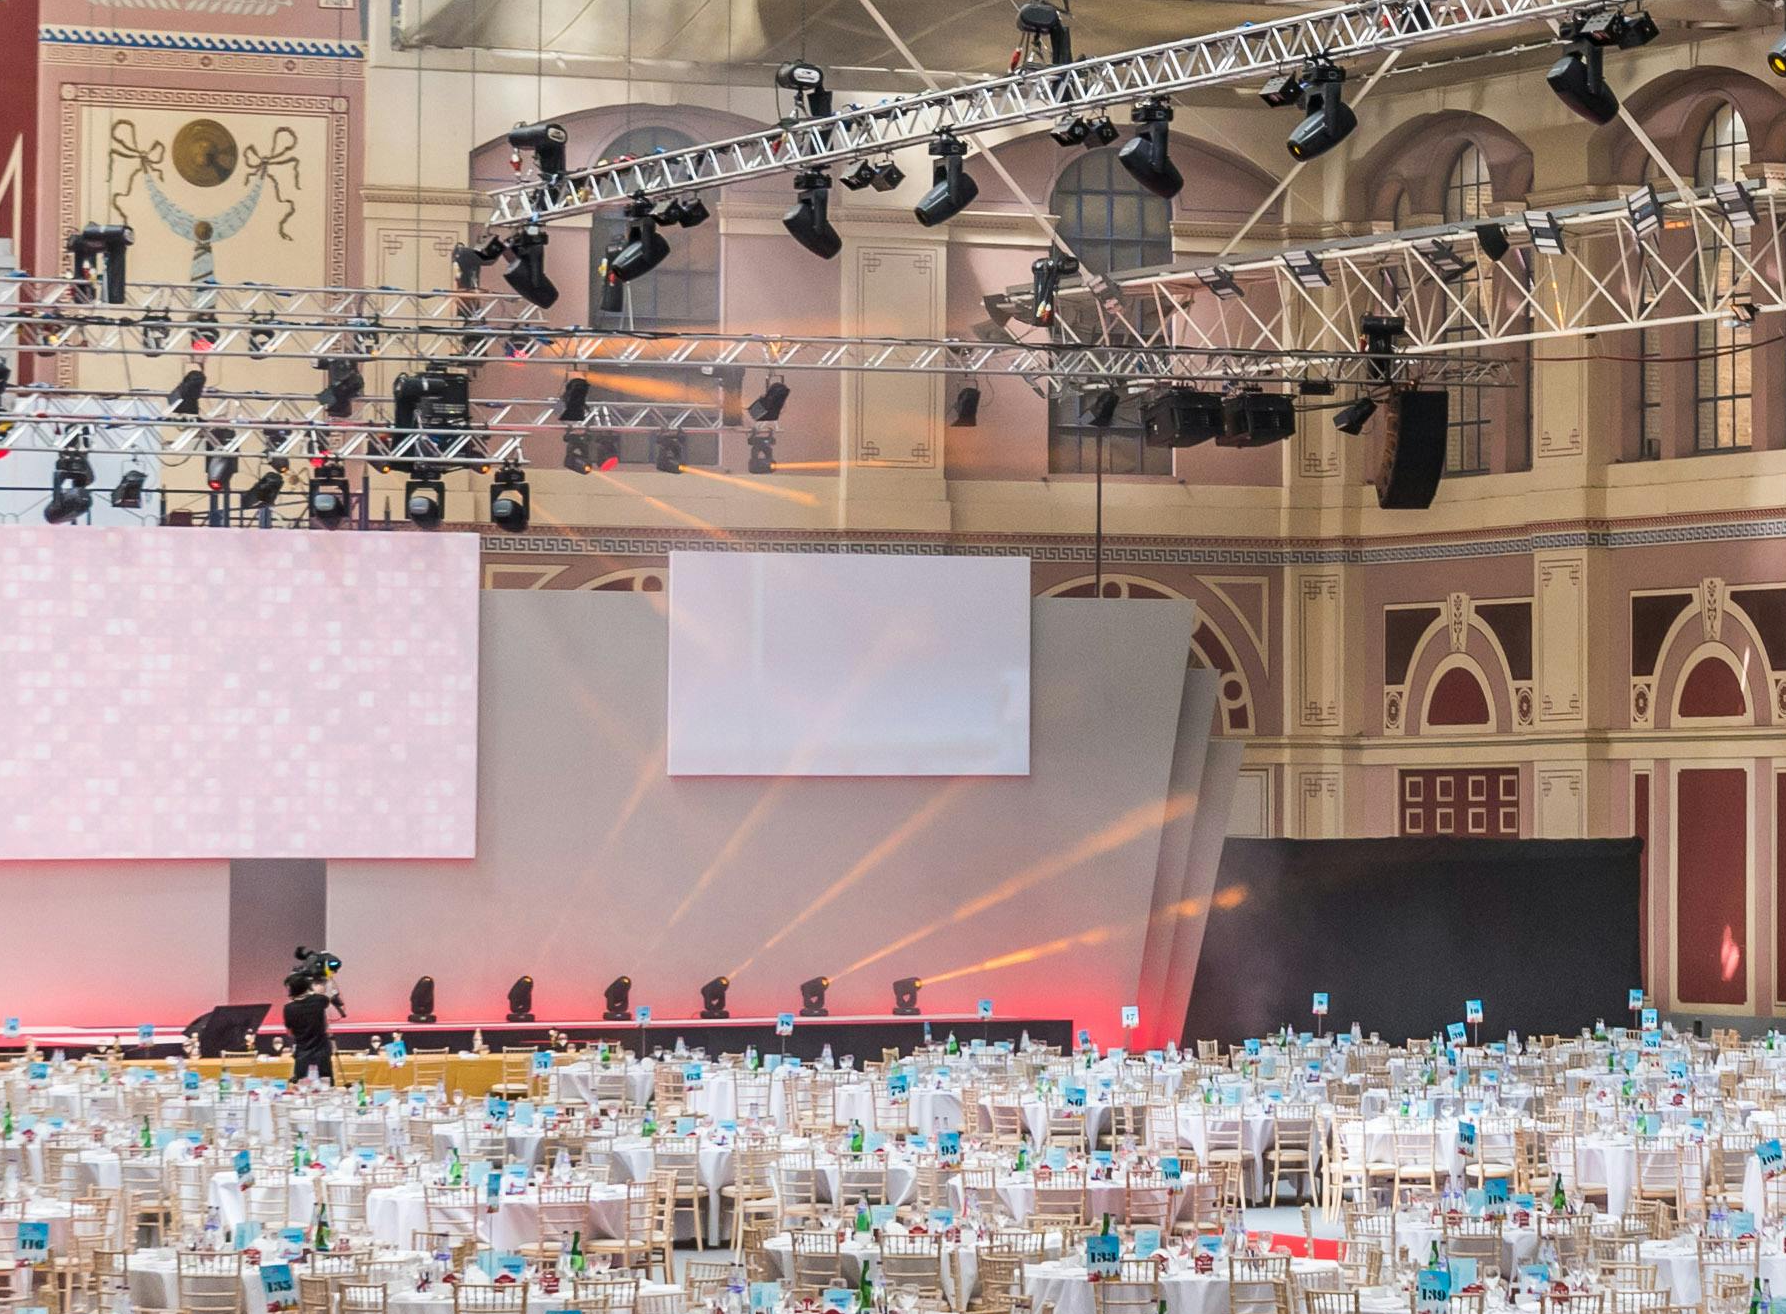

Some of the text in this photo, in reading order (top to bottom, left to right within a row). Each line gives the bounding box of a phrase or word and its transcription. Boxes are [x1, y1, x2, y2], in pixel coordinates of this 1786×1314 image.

[1067, 1098, 1082, 1107] 86
[941, 1145, 957, 1156] 95
[1762, 1153, 1782, 1165] 108
[21, 1239, 45, 1250] 116
[1091, 1252, 1116, 1263] 133
[1422, 1288, 1446, 1301] 139
